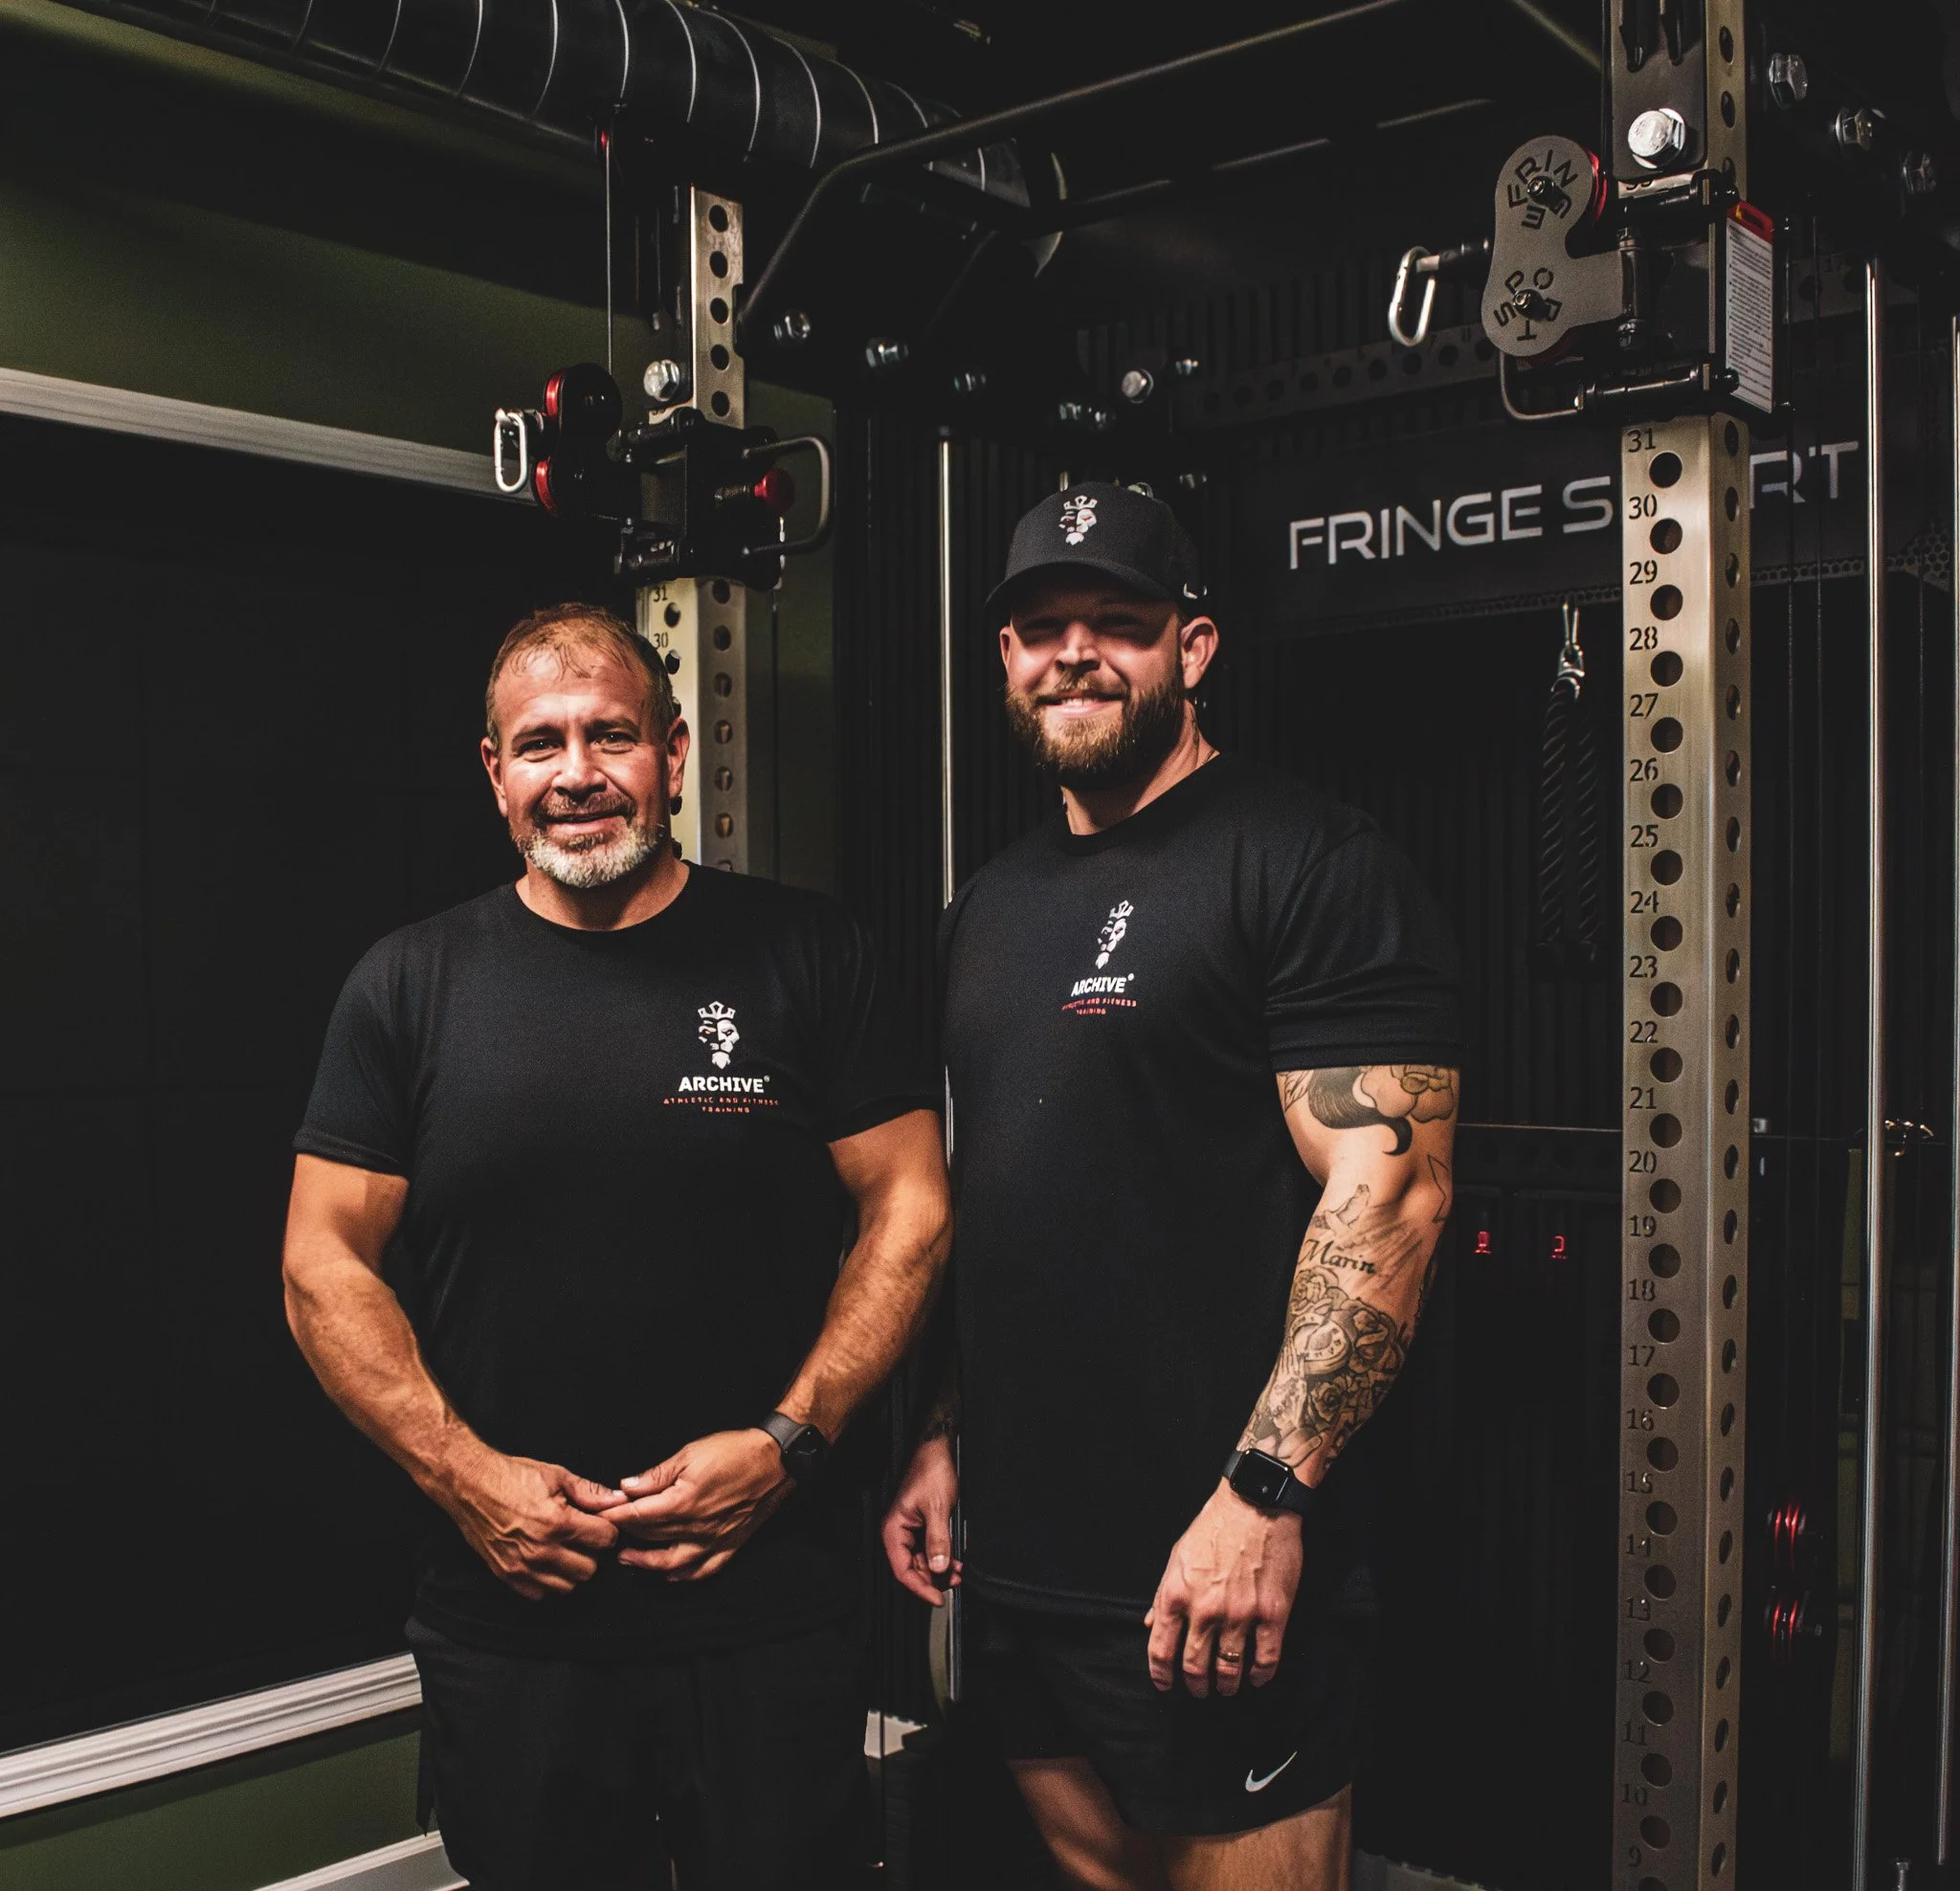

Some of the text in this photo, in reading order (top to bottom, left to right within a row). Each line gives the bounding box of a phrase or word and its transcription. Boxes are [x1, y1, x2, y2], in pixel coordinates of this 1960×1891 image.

[1628, 428, 1657, 453] 31
[1289, 441, 1859, 569] FRINGE SRT
[1629, 494, 1658, 520] 30
[1630, 560, 1658, 585] 29
[653, 585, 668, 603] 31
[653, 632, 669, 650] 30
[1630, 626, 1658, 651] 28
[1630, 694, 1659, 719] 27
[1630, 758, 1658, 782] 26
[1631, 825, 1659, 848] 25
[1630, 891, 1659, 914] 24
[1630, 956, 1658, 978] 23
[1630, 1021, 1658, 1043] 22
[1630, 1087, 1657, 1109] 21
[1629, 1150, 1657, 1173] 20
[1629, 1215, 1657, 1237] 19
[1628, 1279, 1656, 1301] 18
[1628, 1345, 1656, 1367] 17
[1627, 1408, 1655, 1432] 16
[1627, 1471, 1653, 1494] 15
[1626, 1597, 1651, 1621] 13
[1623, 1659, 1650, 1683] 12
[1622, 1722, 1648, 1746] 11
[1621, 1783, 1648, 1806] 10
[1629, 1846, 1641, 1867] 9
